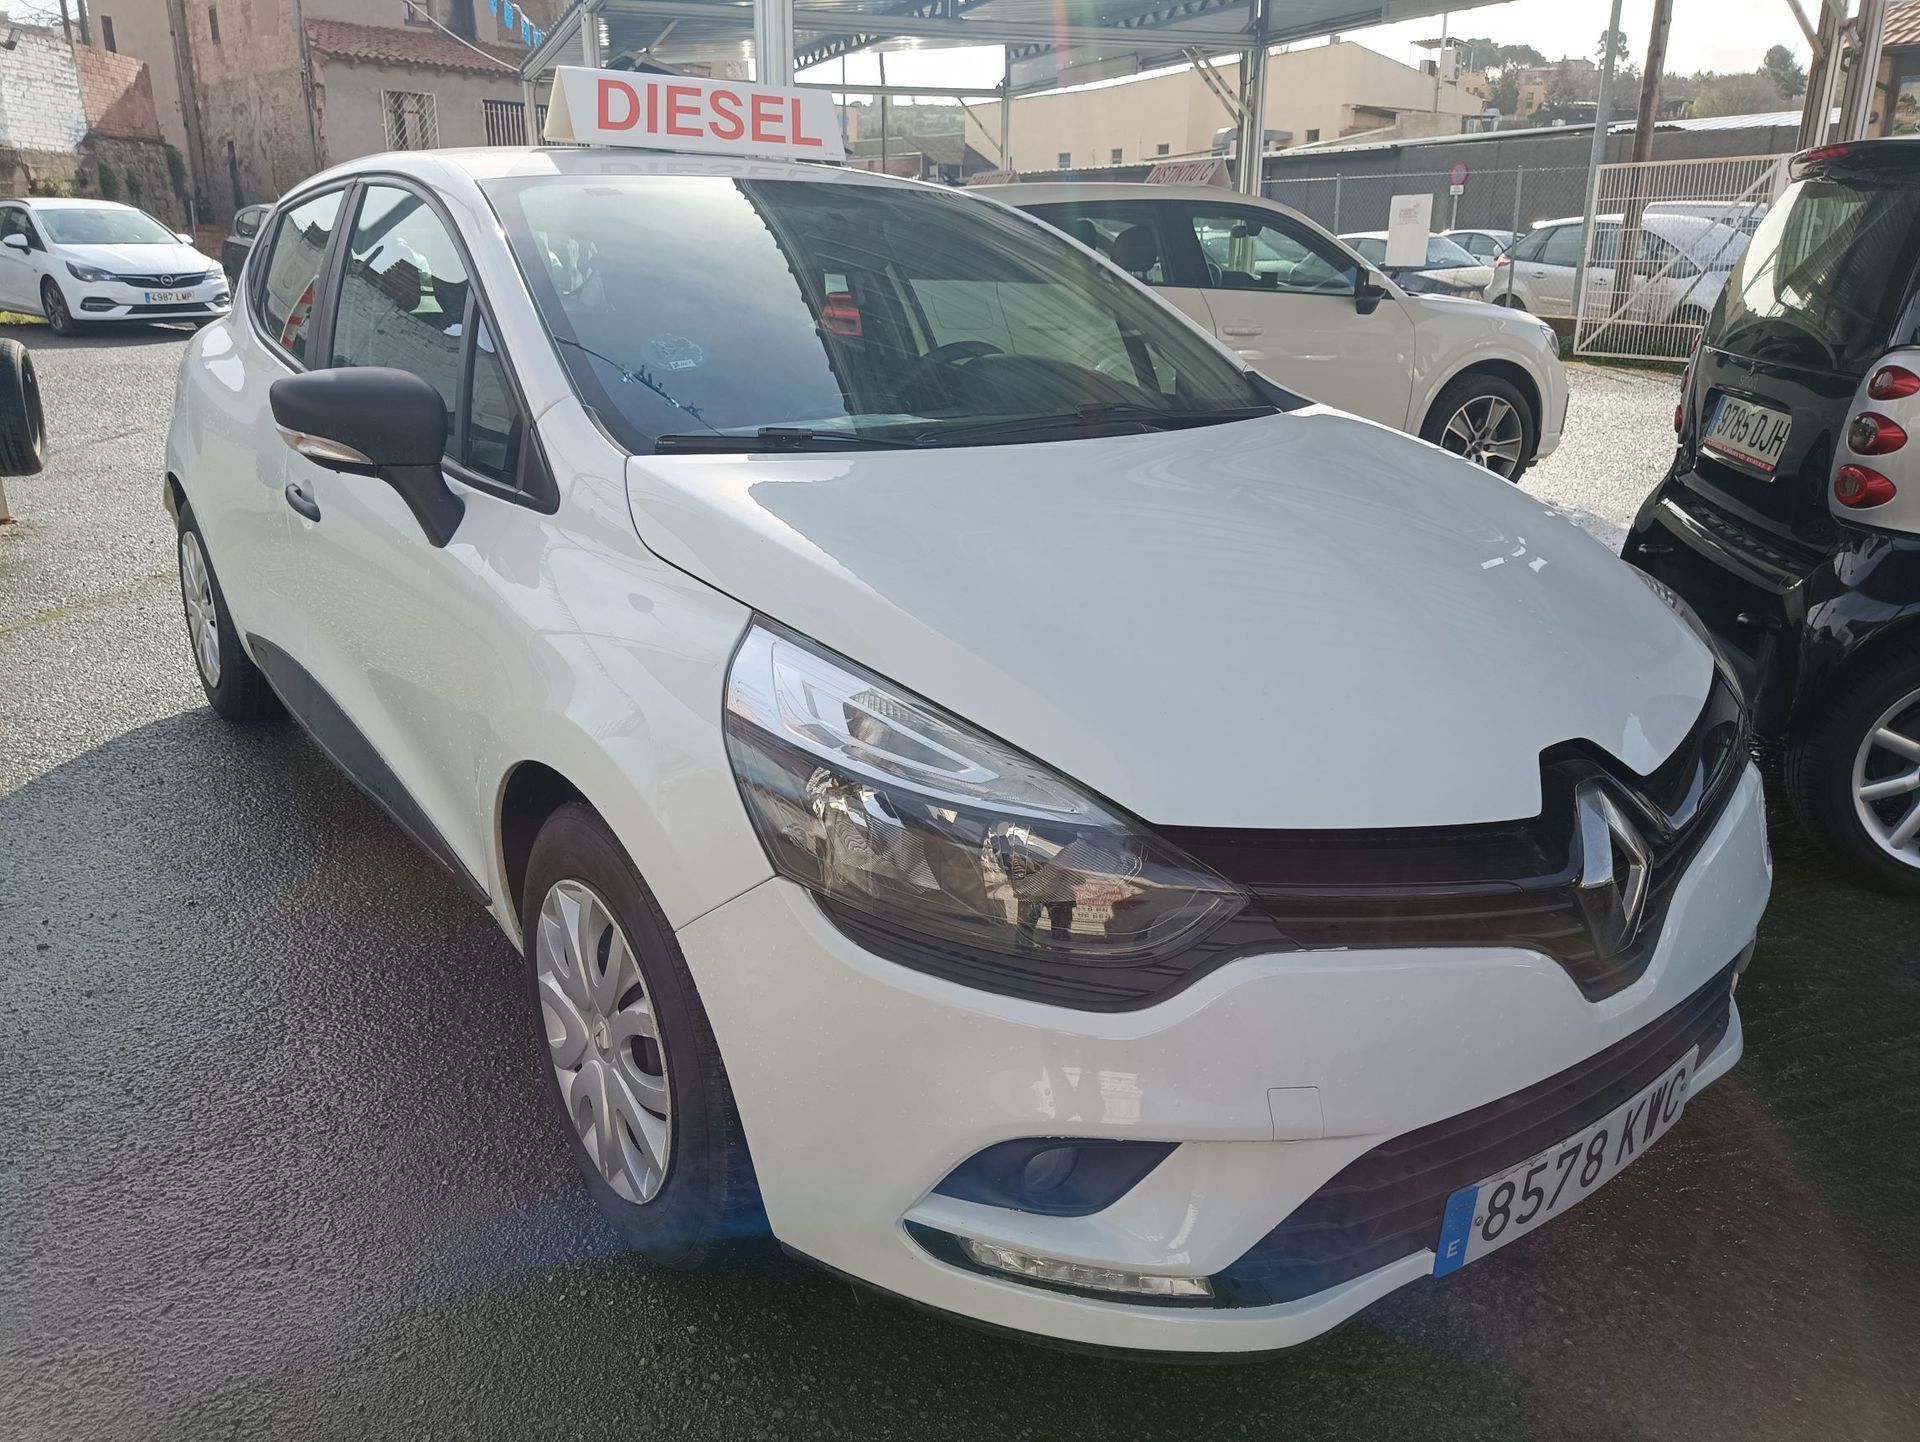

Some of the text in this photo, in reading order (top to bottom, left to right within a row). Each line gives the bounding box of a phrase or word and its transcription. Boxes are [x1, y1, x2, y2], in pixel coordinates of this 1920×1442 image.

[597, 78, 823, 147] DIESEL
[1717, 403, 1756, 443] 9785
[1748, 414, 1791, 457] DJH
[1482, 1068, 1686, 1242] 8578 KWC
[1446, 1239, 1460, 1258] E
